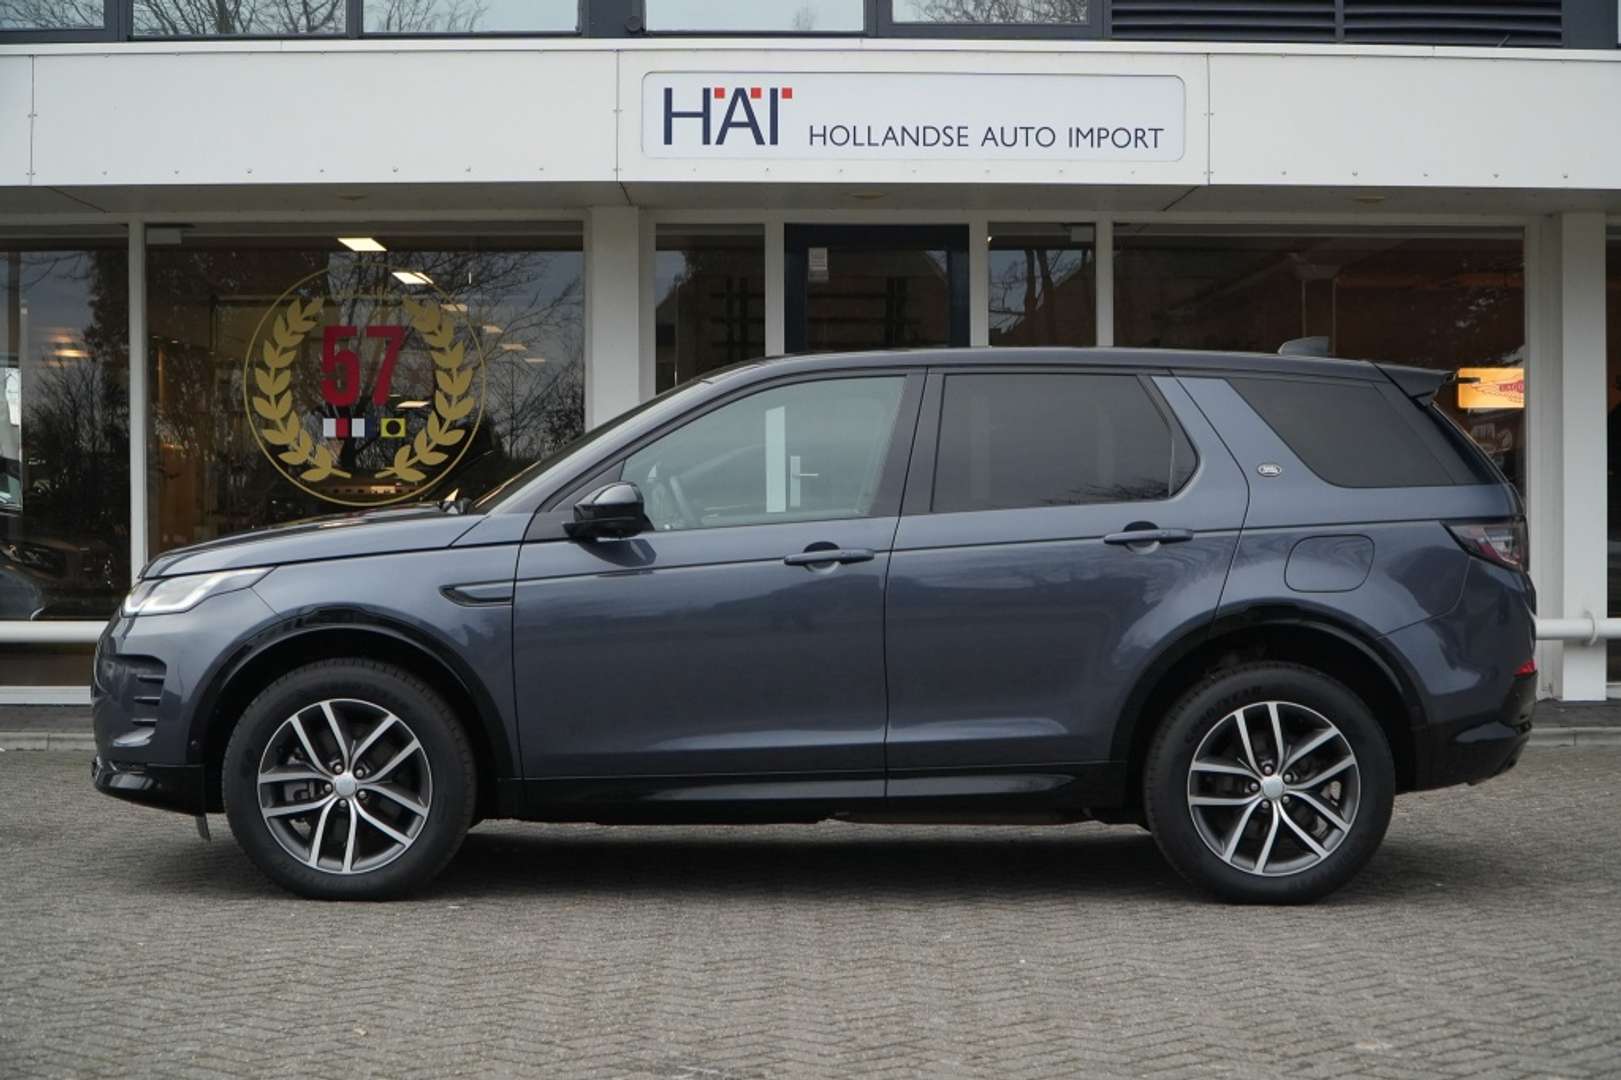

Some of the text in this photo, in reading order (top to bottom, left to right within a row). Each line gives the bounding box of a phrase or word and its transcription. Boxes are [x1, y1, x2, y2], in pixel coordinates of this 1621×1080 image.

[809, 125, 1164, 149] HOLLANDSE AUTO IMPORT
[320, 325, 405, 408] 57
